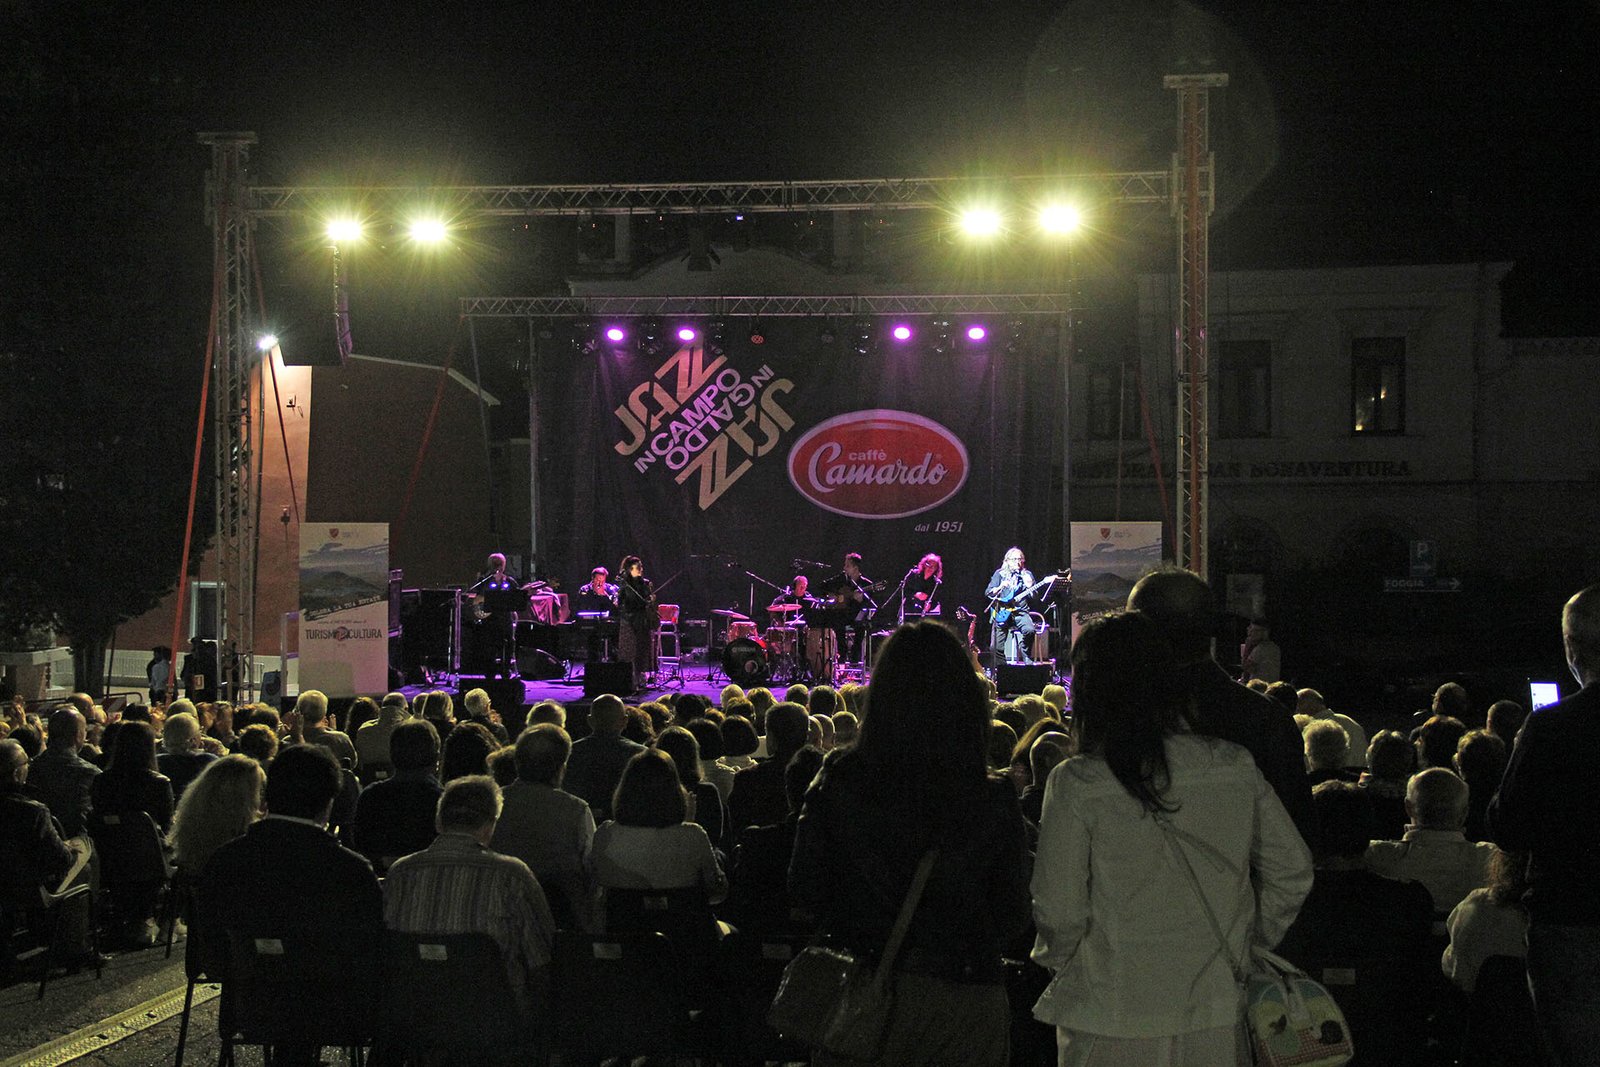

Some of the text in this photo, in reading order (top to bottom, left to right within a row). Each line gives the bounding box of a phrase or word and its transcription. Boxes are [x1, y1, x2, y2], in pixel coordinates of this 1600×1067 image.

[633, 368, 741, 474] IN CAMPO
[848, 448, 888, 462] caffè
[808, 441, 949, 493] Camardo
[1250, 461, 1412, 478] BONAVENTURA
[914, 522, 964, 533] dal 1951
